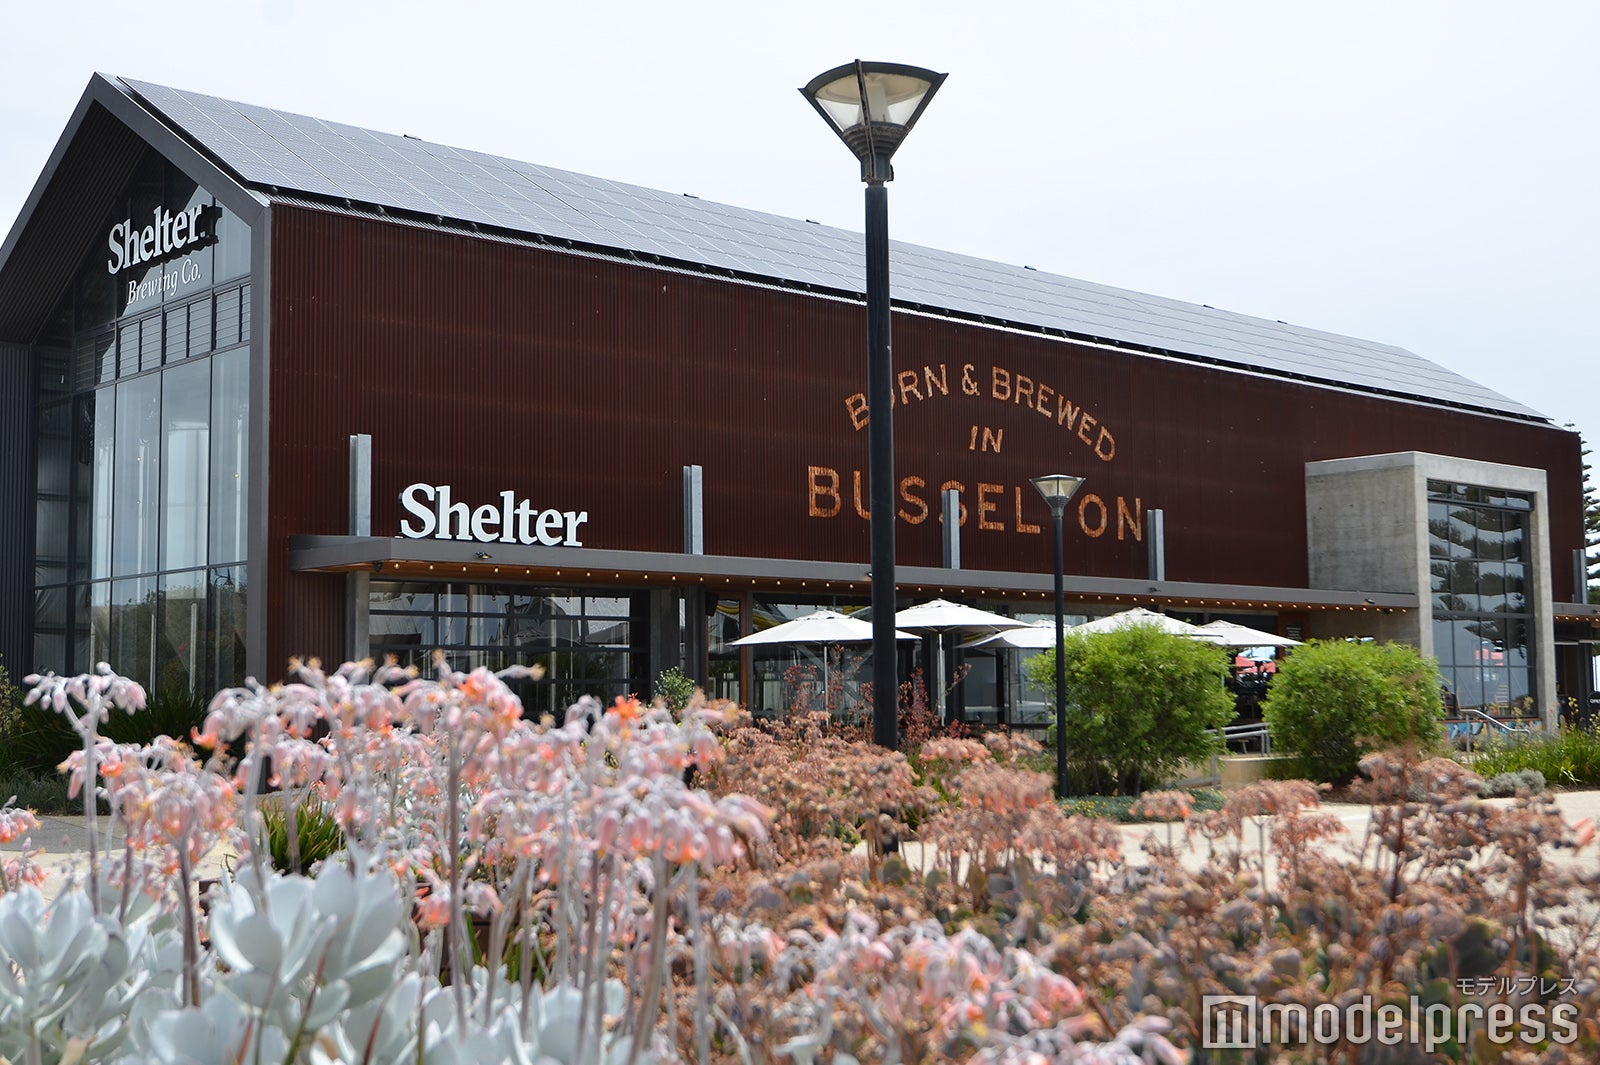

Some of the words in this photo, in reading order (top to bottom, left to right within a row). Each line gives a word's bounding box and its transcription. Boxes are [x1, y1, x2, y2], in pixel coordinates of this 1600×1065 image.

[127, 269, 178, 305] Brewing
[182, 258, 201, 285] Co.
[845, 364, 949, 431] BRN
[961, 363, 980, 396] &
[991, 366, 1116, 461] BREWED
[969, 425, 1003, 453] IN
[400, 482, 588, 547] Shelter
